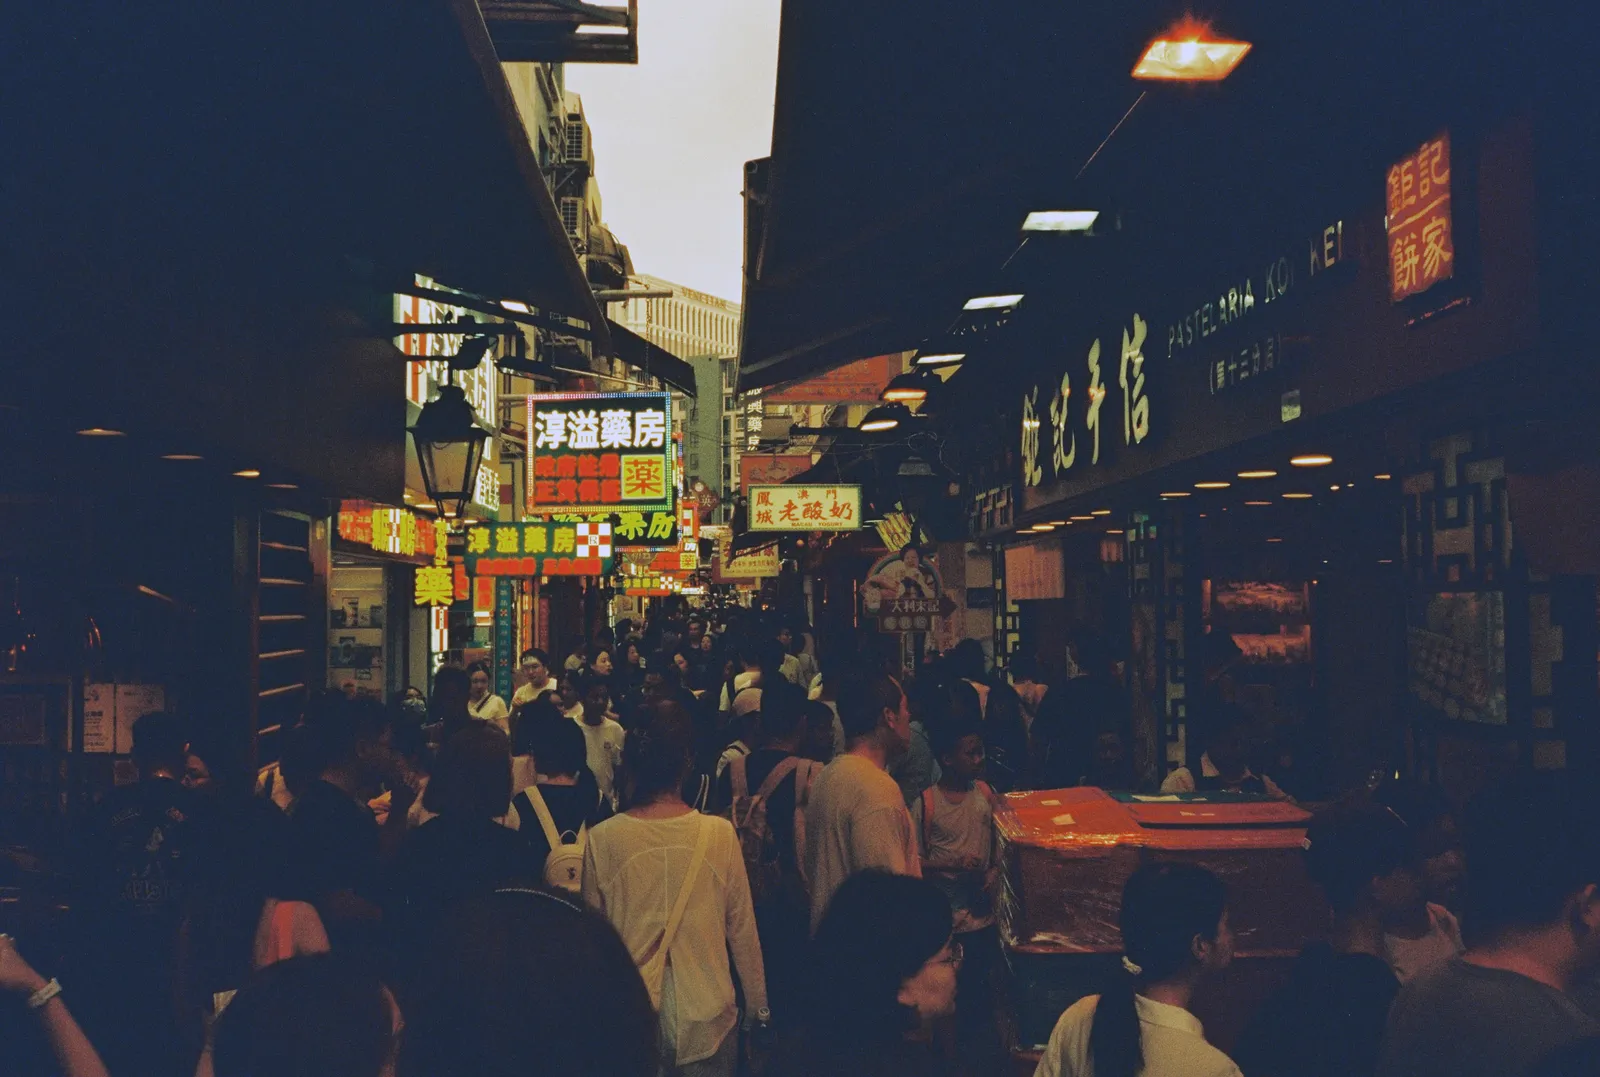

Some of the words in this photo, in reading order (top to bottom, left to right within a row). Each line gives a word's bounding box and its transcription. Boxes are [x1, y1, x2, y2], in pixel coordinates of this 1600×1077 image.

[1387, 139, 1450, 218] 鉅記
[1167, 277, 1255, 359] PASTELARIA
[1308, 219, 1343, 277] KEI
[534, 408, 666, 449] 淳溢藥房
[778, 499, 854, 522] 老酸奶
[797, 488, 838, 500] 澳門
[467, 525, 575, 554] 淳溢藥房
